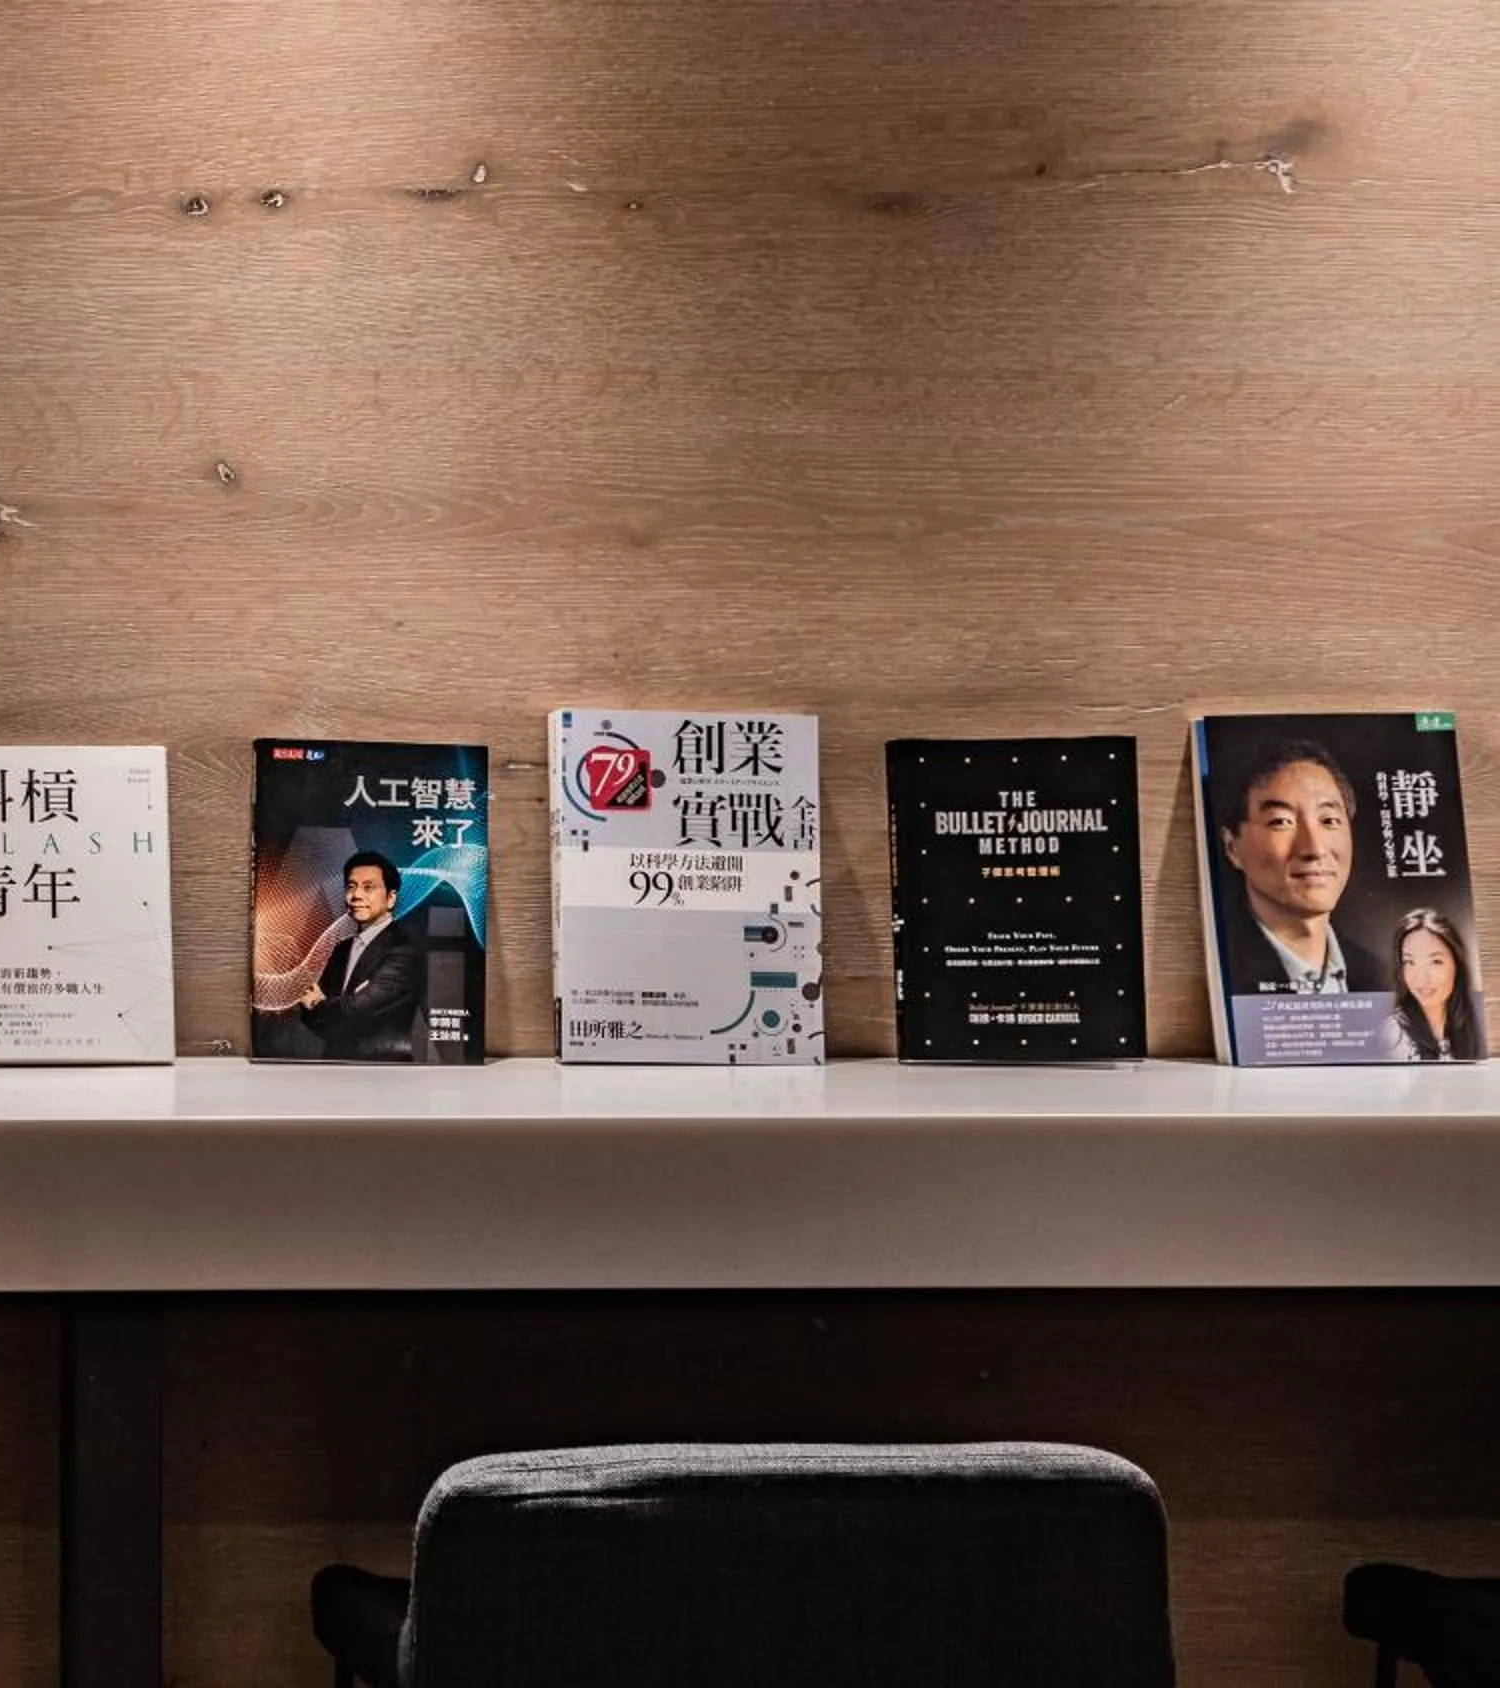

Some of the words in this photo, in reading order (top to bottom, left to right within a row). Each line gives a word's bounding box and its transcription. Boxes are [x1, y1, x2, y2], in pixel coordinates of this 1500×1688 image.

[671, 719, 784, 776] 創業
[344, 775, 476, 810] 人工智慧
[591, 753, 635, 797] 79
[999, 791, 1036, 808] THE
[412, 816, 474, 849] 來了
[672, 791, 785, 848] 實戰
[791, 796, 817, 850] 全書
[935, 811, 1007, 835] BULLET
[1017, 808, 1108, 833] JOURNAL
[1391, 769, 1447, 877] 靜坐
[979, 836, 1060, 855] METHOD
